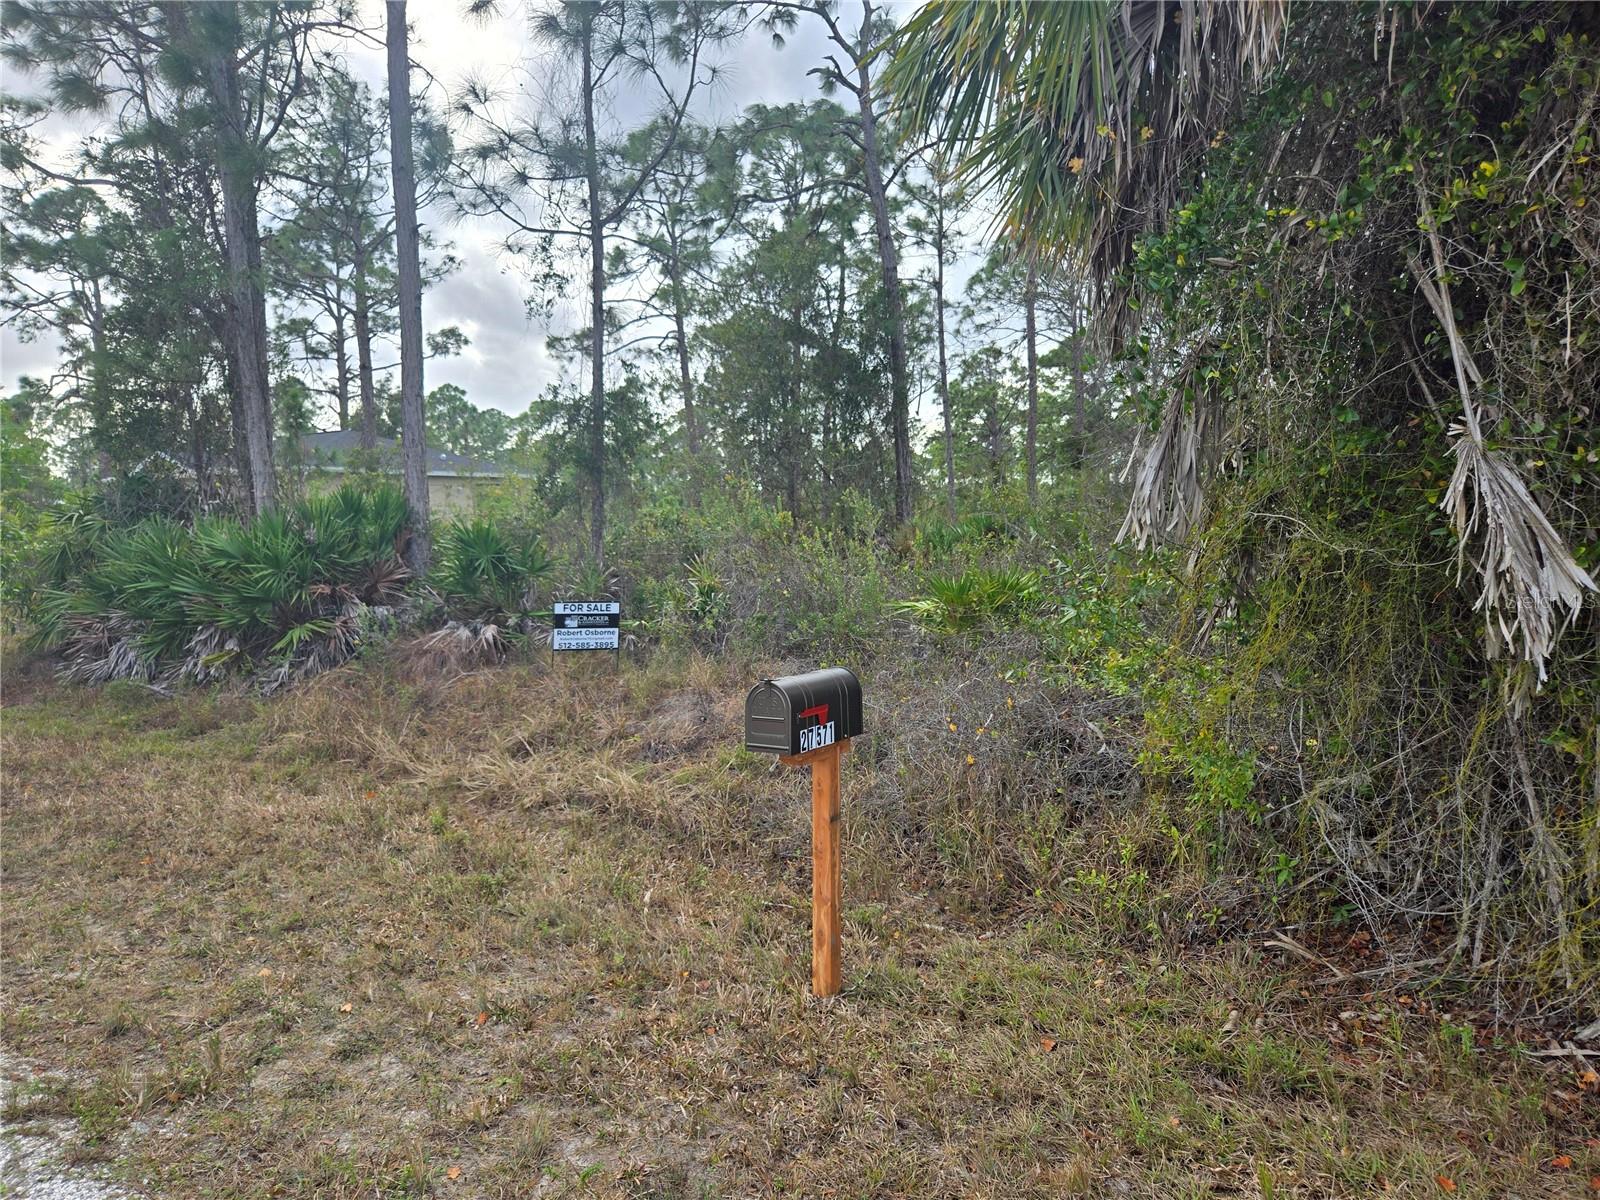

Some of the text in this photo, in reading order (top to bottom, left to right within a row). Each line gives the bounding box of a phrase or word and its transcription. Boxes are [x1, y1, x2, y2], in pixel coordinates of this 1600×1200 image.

[563, 604, 612, 612] FOR SALE
[558, 641, 615, 649] 512-585-3895
[801, 723, 833, 752] 27571
